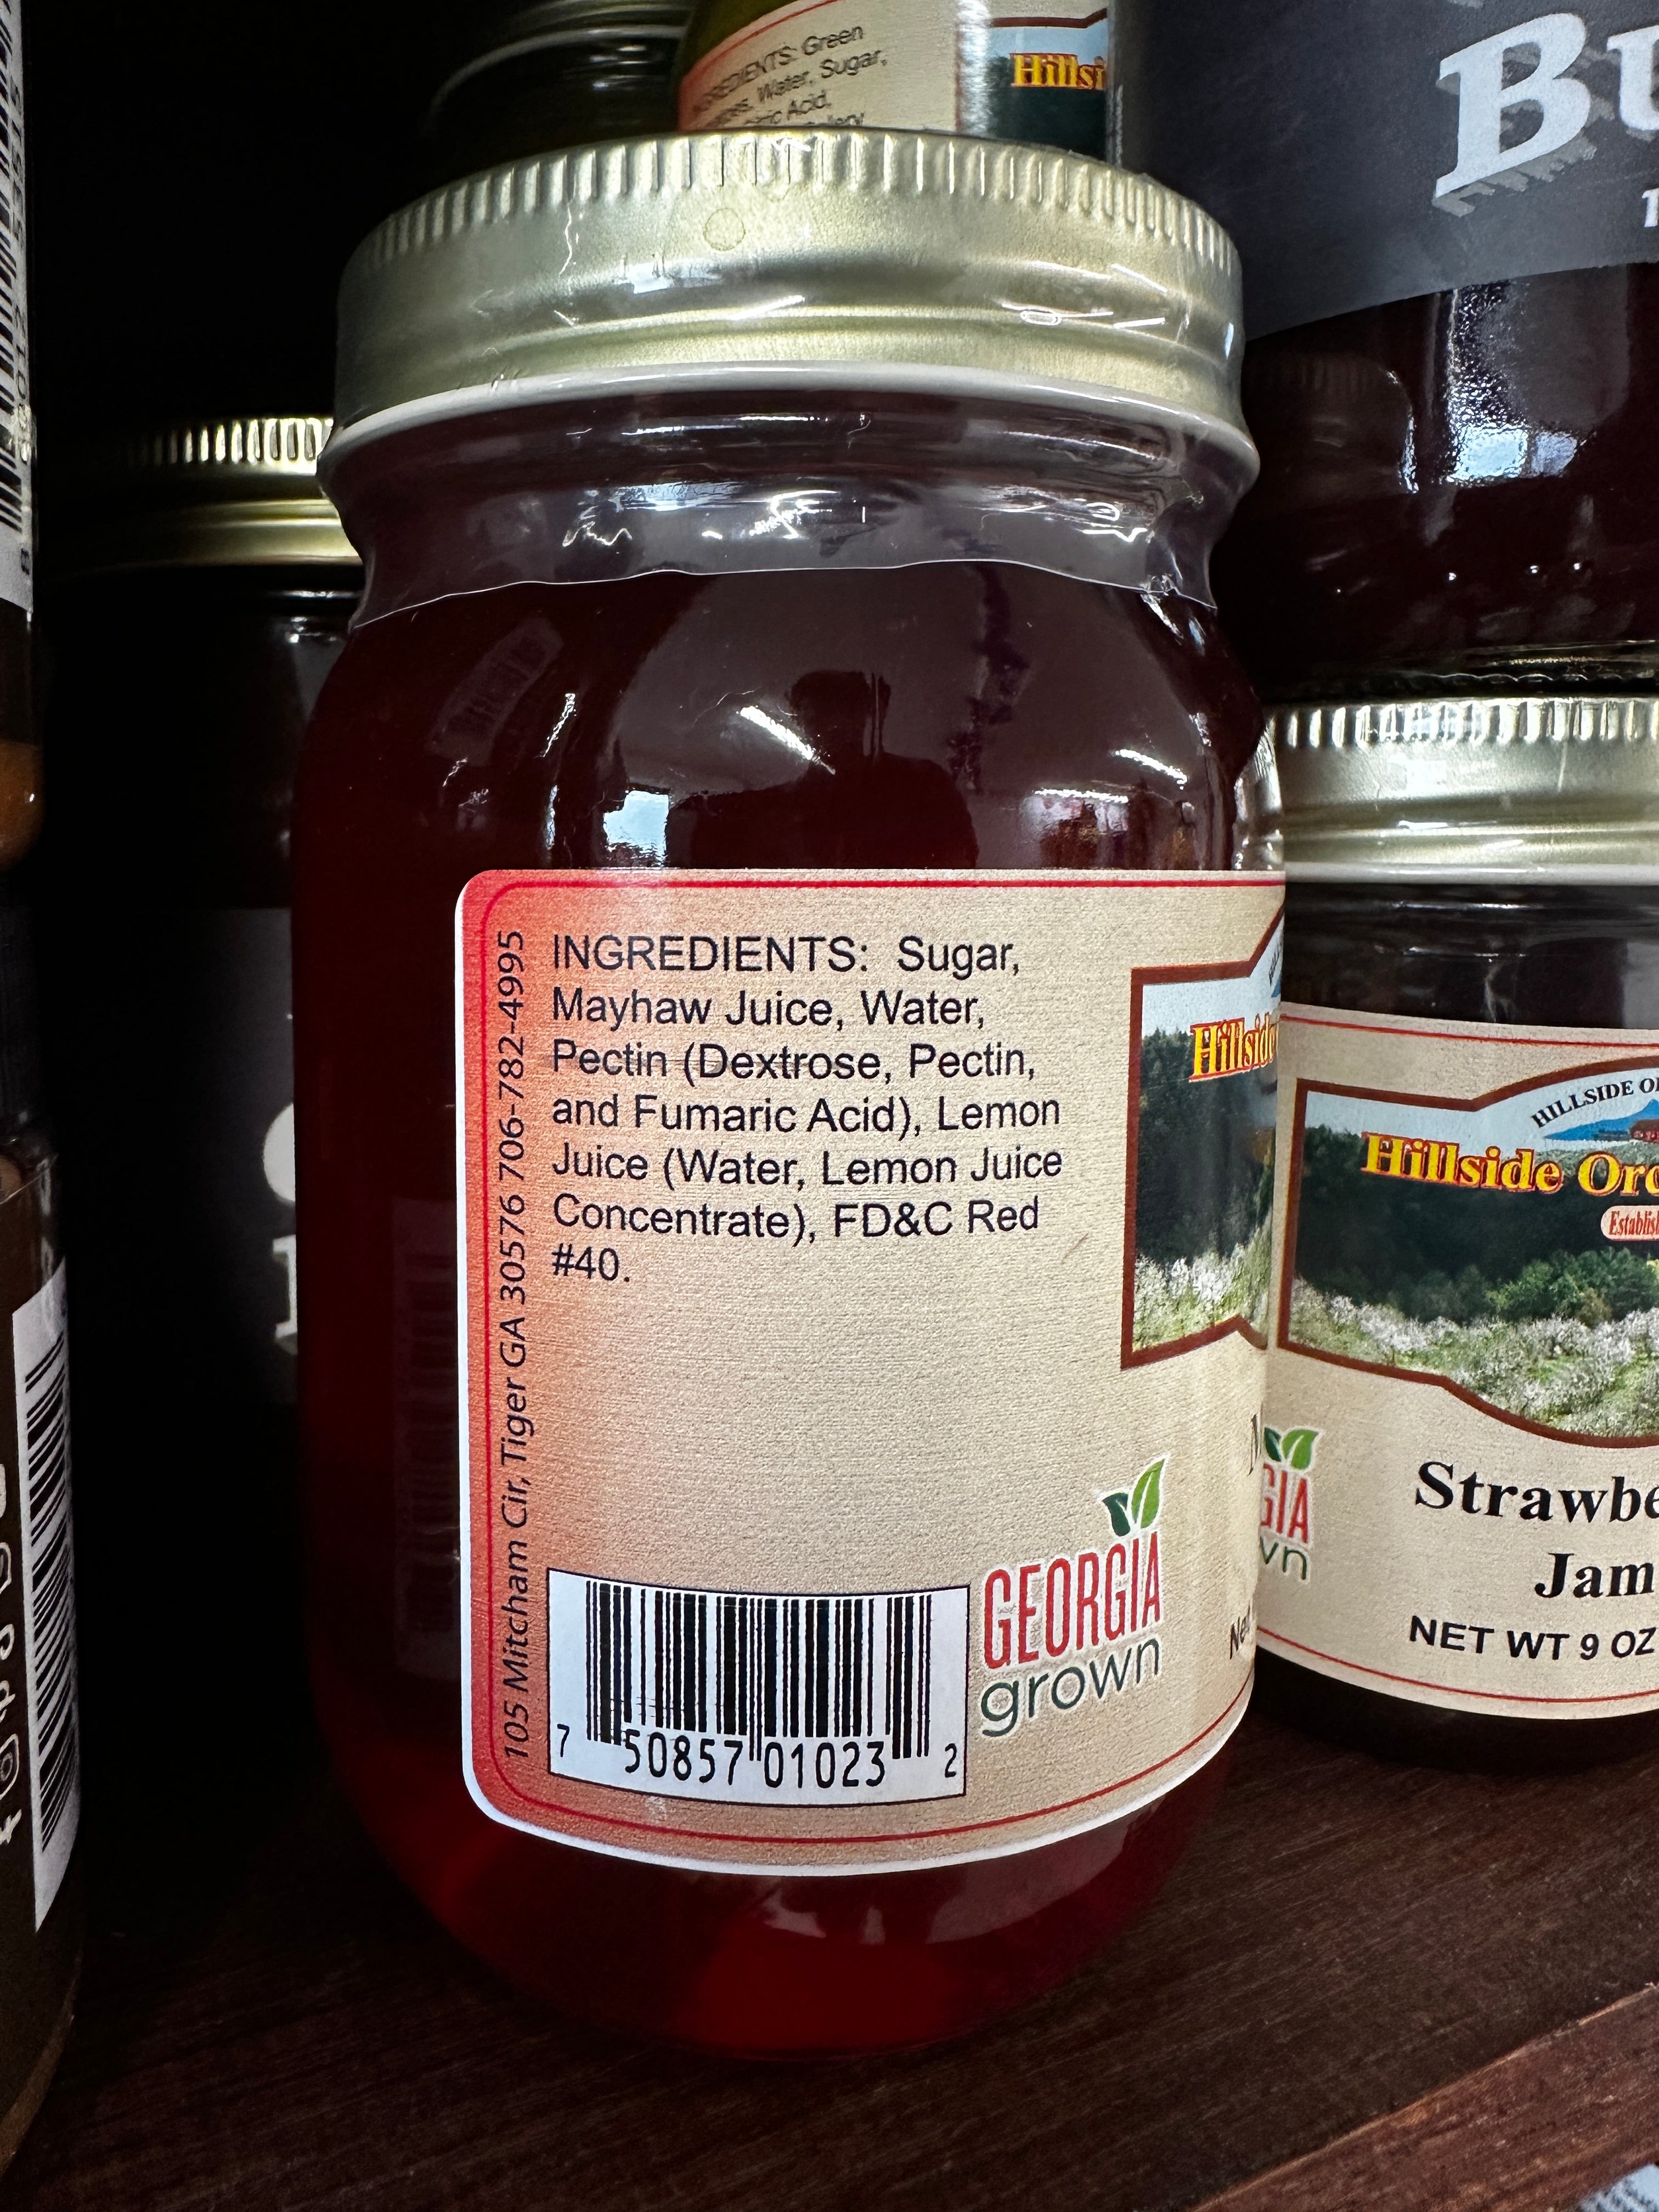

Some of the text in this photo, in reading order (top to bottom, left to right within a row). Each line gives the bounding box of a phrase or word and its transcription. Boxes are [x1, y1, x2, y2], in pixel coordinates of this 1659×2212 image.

[802, 26, 864, 55] Green
[820, 50, 888, 78] Sugar,
[553, 935, 1020, 979] INGREDIENTS: Sugar,
[552, 988, 984, 1031] Mayhaw Juice, Water,
[553, 1039, 1035, 1087] Pectin (Dextrose, Pectin,
[552, 1094, 1059, 1141] and Fumaric Acid), Lemon
[1530, 1080, 1634, 1128] HILLSIDE
[552, 1142, 1063, 1191] Juice (Water, Lemon Juice
[1360, 1131, 1565, 1195] Hillside
[553, 1193, 1039, 1246] Concentrate), FD&C Red
[552, 1244, 630, 1282] #40.
[498, 930, 534, 1758] 105 Mitcham Cir, Tiger GA 30576 706-782-4995
[1534, 1551, 1655, 1599] Jam
[982, 1531, 1164, 1670] GEORGIA
[1409, 1615, 1494, 1654] NET
[1506, 1629, 1571, 1661] WT
[1580, 1633, 1599, 1661] 9
[980, 1636, 1161, 1737] grown
[556, 1724, 957, 1790] 7 50857 01023 2
